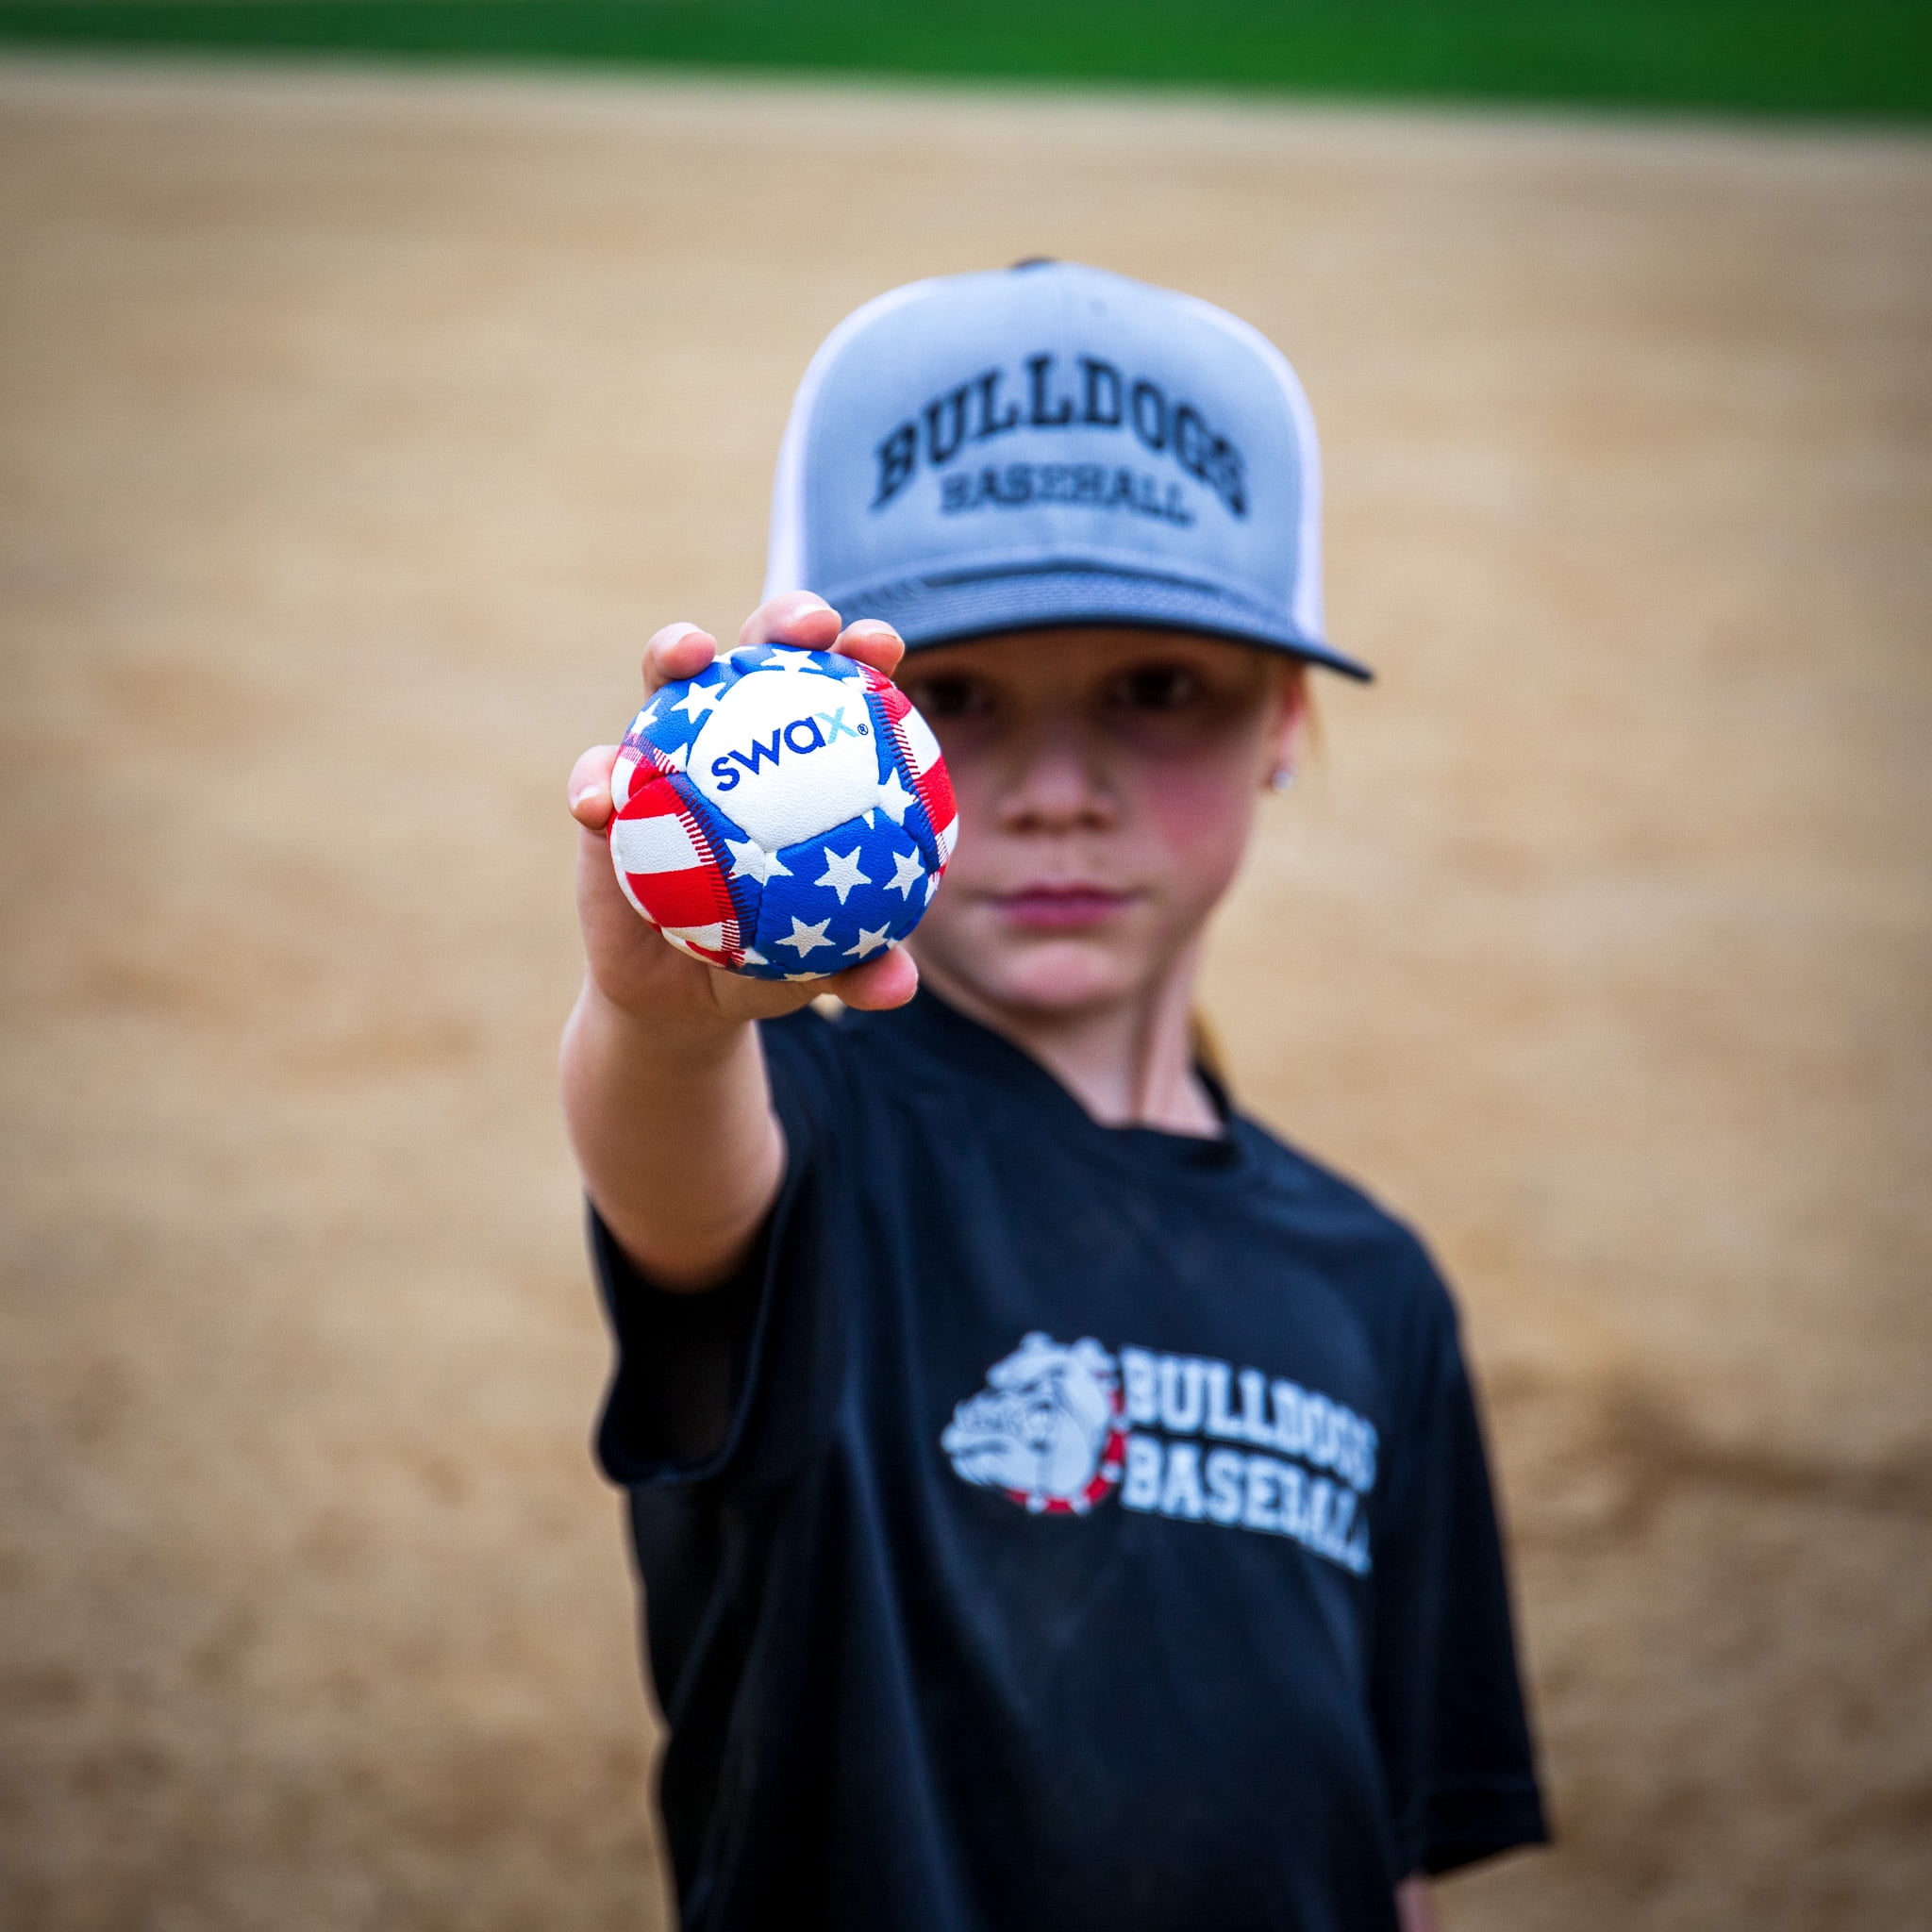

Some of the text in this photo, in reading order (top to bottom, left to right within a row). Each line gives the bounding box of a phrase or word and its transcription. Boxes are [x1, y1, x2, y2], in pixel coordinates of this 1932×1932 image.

[870, 352, 1248, 520] BULLDOGS
[940, 463, 1194, 528] BASEBALL
[1120, 1347, 1378, 1493] BULLDOGS
